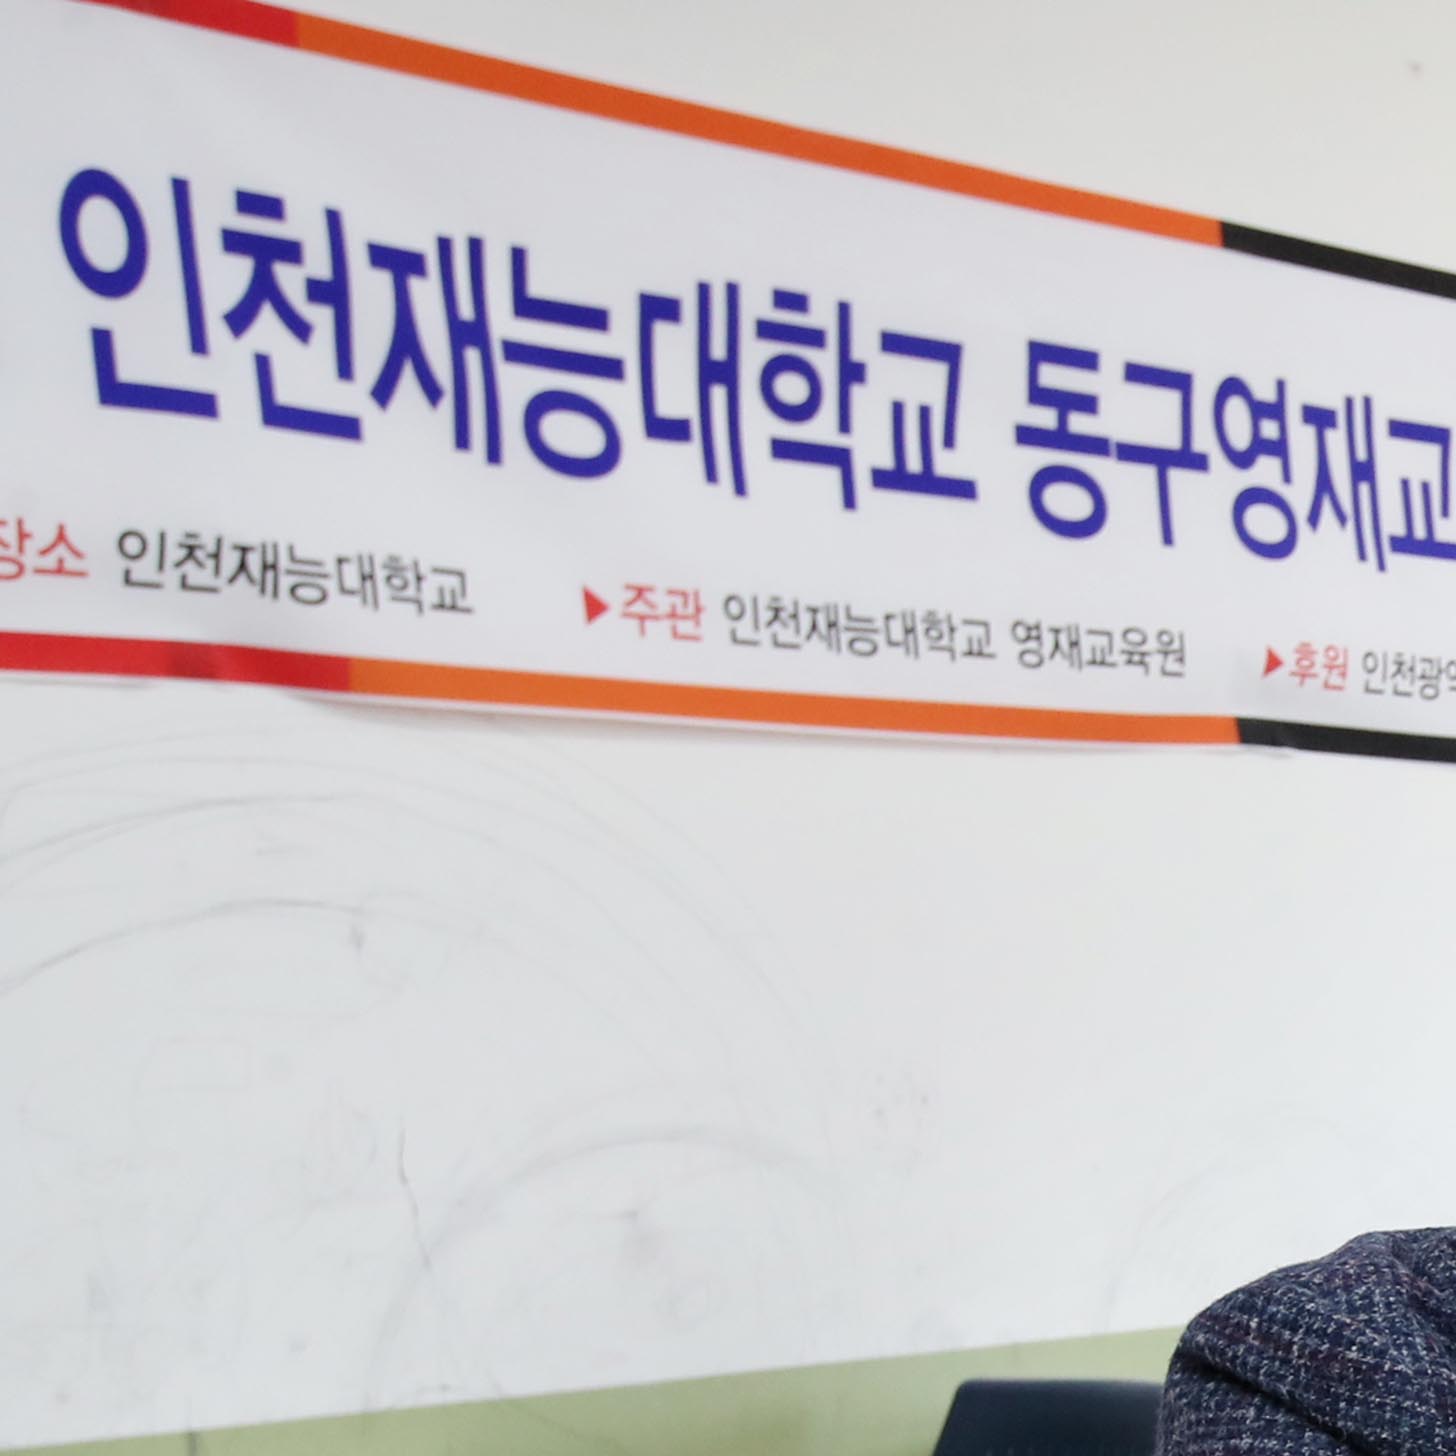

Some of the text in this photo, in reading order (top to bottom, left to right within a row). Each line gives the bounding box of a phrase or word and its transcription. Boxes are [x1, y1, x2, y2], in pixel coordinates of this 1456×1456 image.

[58, 167, 979, 512] 인천재능대학교
[0, 517, 474, 615] 장소 인천재능대학교
[620, 583, 1187, 678] 주관 인천재능대학교 영재교육원
[1288, 641, 1350, 692] 후원
